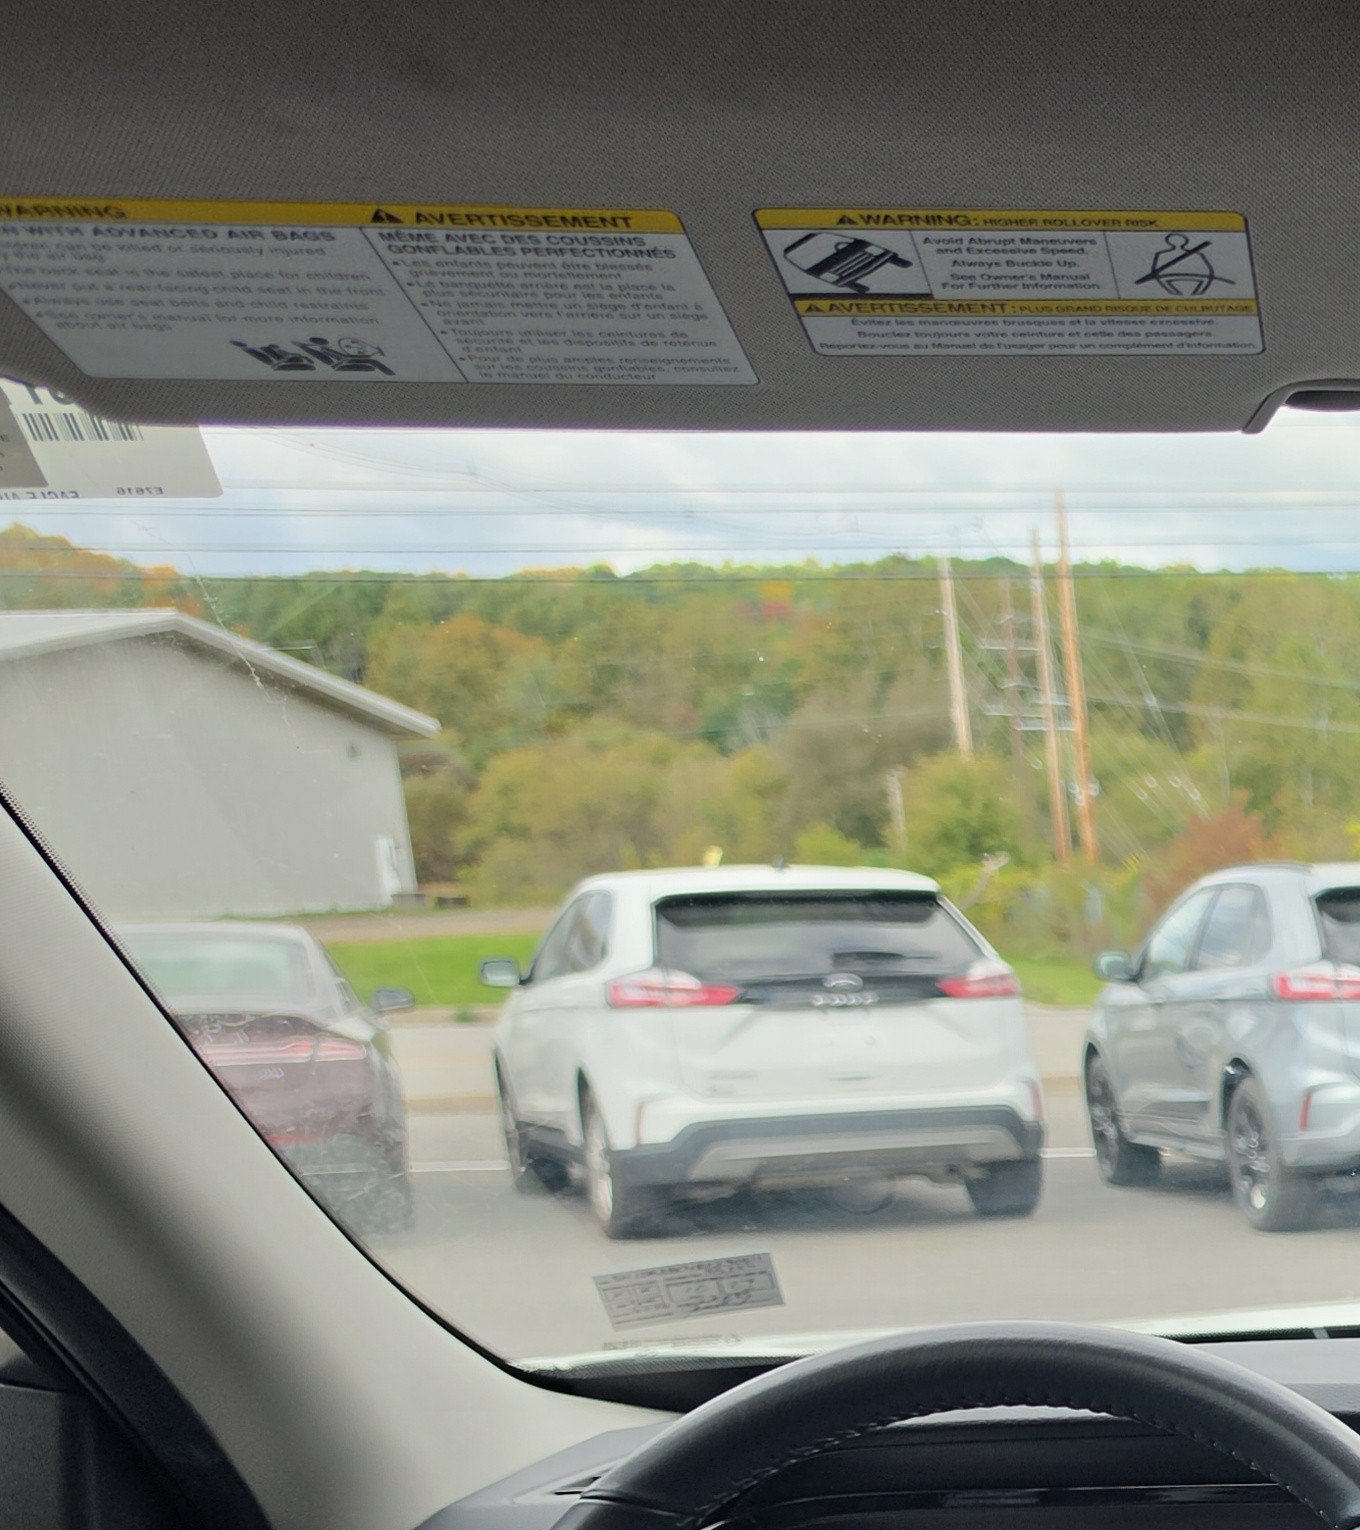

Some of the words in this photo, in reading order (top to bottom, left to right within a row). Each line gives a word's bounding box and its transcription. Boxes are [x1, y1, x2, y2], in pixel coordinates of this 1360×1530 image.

[415, 212, 632, 229] AVERTISSEMENT
[858, 214, 979, 226] WARNING:
[983, 218, 1039, 227] HIGHER
[1043, 218, 1122, 227] ROLLOVER
[1126, 219, 1159, 227] RISK
[93, 227, 217, 239] ADVANCED
[228, 229, 265, 241] AIR
[274, 230, 337, 242] BAGS
[379, 231, 437, 244] MÊME
[445, 233, 495, 244] AVEC
[503, 235, 540, 245] DES
[546, 235, 645, 247] COUSSINS
[923, 237, 963, 246] Avoid
[968, 237, 1015, 246] Abrupt
[1020, 237, 1097, 246] Maneuvers
[388, 244, 517, 257] GONFLABLES
[524, 246, 676, 259] PERFECTIONNÉS
[967, 246, 1037, 254] Excessive
[1041, 246, 1088, 255] Speed.
[952, 260, 1000, 268] Always
[1005, 260, 1054, 268] Buckle
[1057, 260, 1080, 268] Up.
[950, 273, 976, 281] See
[1040, 273, 1090, 281] Manual
[941, 282, 964, 290] For
[969, 282, 1018, 290] Further
[1020, 305, 1053, 313] PLUS
[1056, 305, 1102, 313] GRAND
[1106, 305, 1152, 313] RISQUE
[1175, 304, 1252, 313] CULBUTAGE
